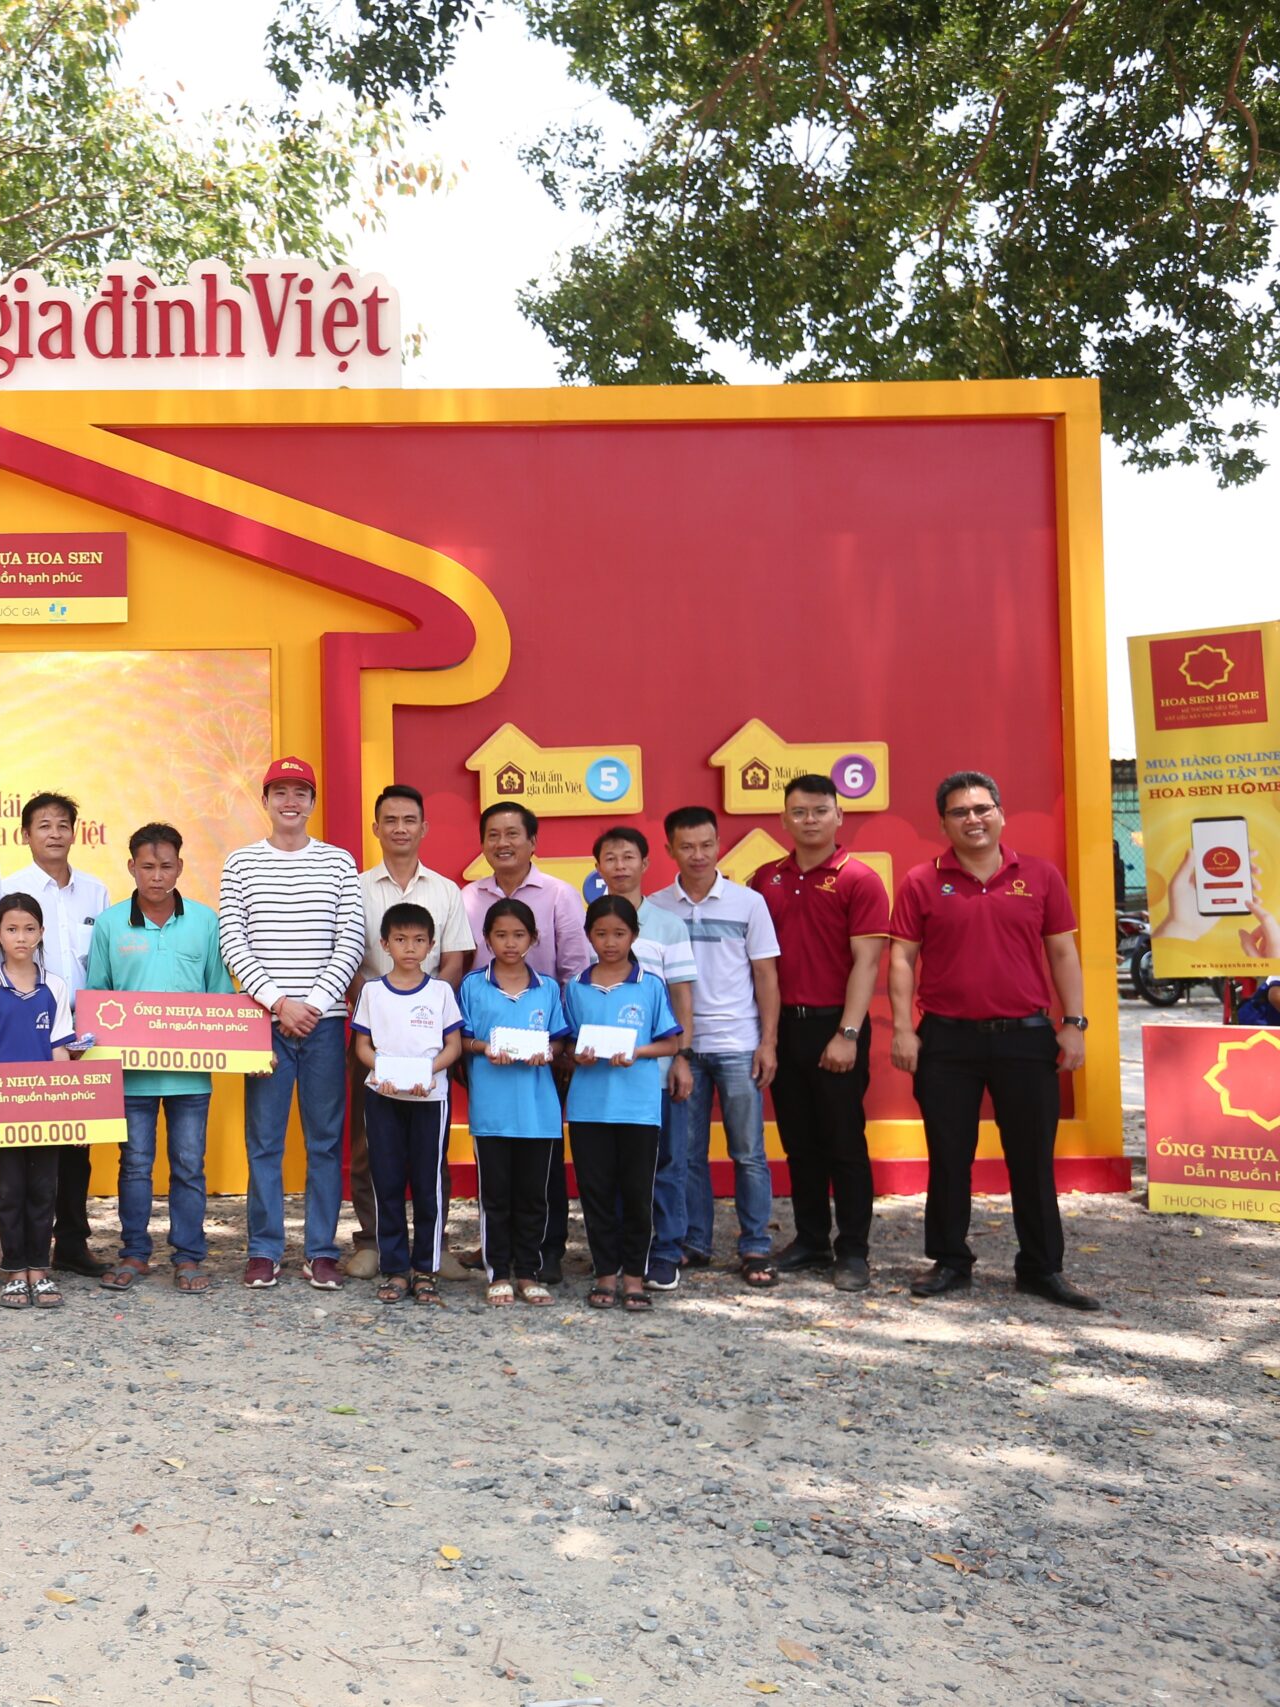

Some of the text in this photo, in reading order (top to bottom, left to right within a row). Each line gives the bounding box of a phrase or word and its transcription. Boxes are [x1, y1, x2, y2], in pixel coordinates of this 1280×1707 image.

[85, 272, 243, 359] đình
[246, 271, 391, 373] Việt
[26, 552, 64, 565] HOA
[68, 551, 103, 565] SEN
[19, 572, 50, 585] hạnh
[52, 571, 83, 585] phúc
[22, 607, 40, 617] GIA
[1161, 691, 1259, 707] HOA SEN HOME
[1145, 751, 1280, 769] MUA HÀNG ONLINE
[599, 767, 618, 791] 5
[844, 764, 864, 788] 6
[1144, 772, 1179, 784] GIAO
[1182, 769, 1223, 781] HÀNG
[526, 783, 540, 797] gia
[1149, 788, 1185, 799] HOA
[1188, 785, 1222, 797] SEN
[133, 1001, 264, 1019] ỐNG NHỰA HOA SEN
[149, 1019, 249, 1032] Dẫn nguồn hạnh phúc
[120, 1049, 227, 1070] 10.000.000
[6, 1075, 46, 1090] NHỰA
[50, 1075, 80, 1086] HOA
[83, 1073, 112, 1085] SEN
[11, 1091, 43, 1104] nguồn
[45, 1091, 70, 1103] hạnh
[71, 1090, 96, 1102] phúc
[1156, 1135, 1279, 1164] ỐNG NHỰA
[1184, 1163, 1216, 1178] Dẫn
[1220, 1165, 1271, 1182] nguồn
[1162, 1194, 1227, 1209] THƯƠNG
[1232, 1200, 1264, 1212] HIỆU
